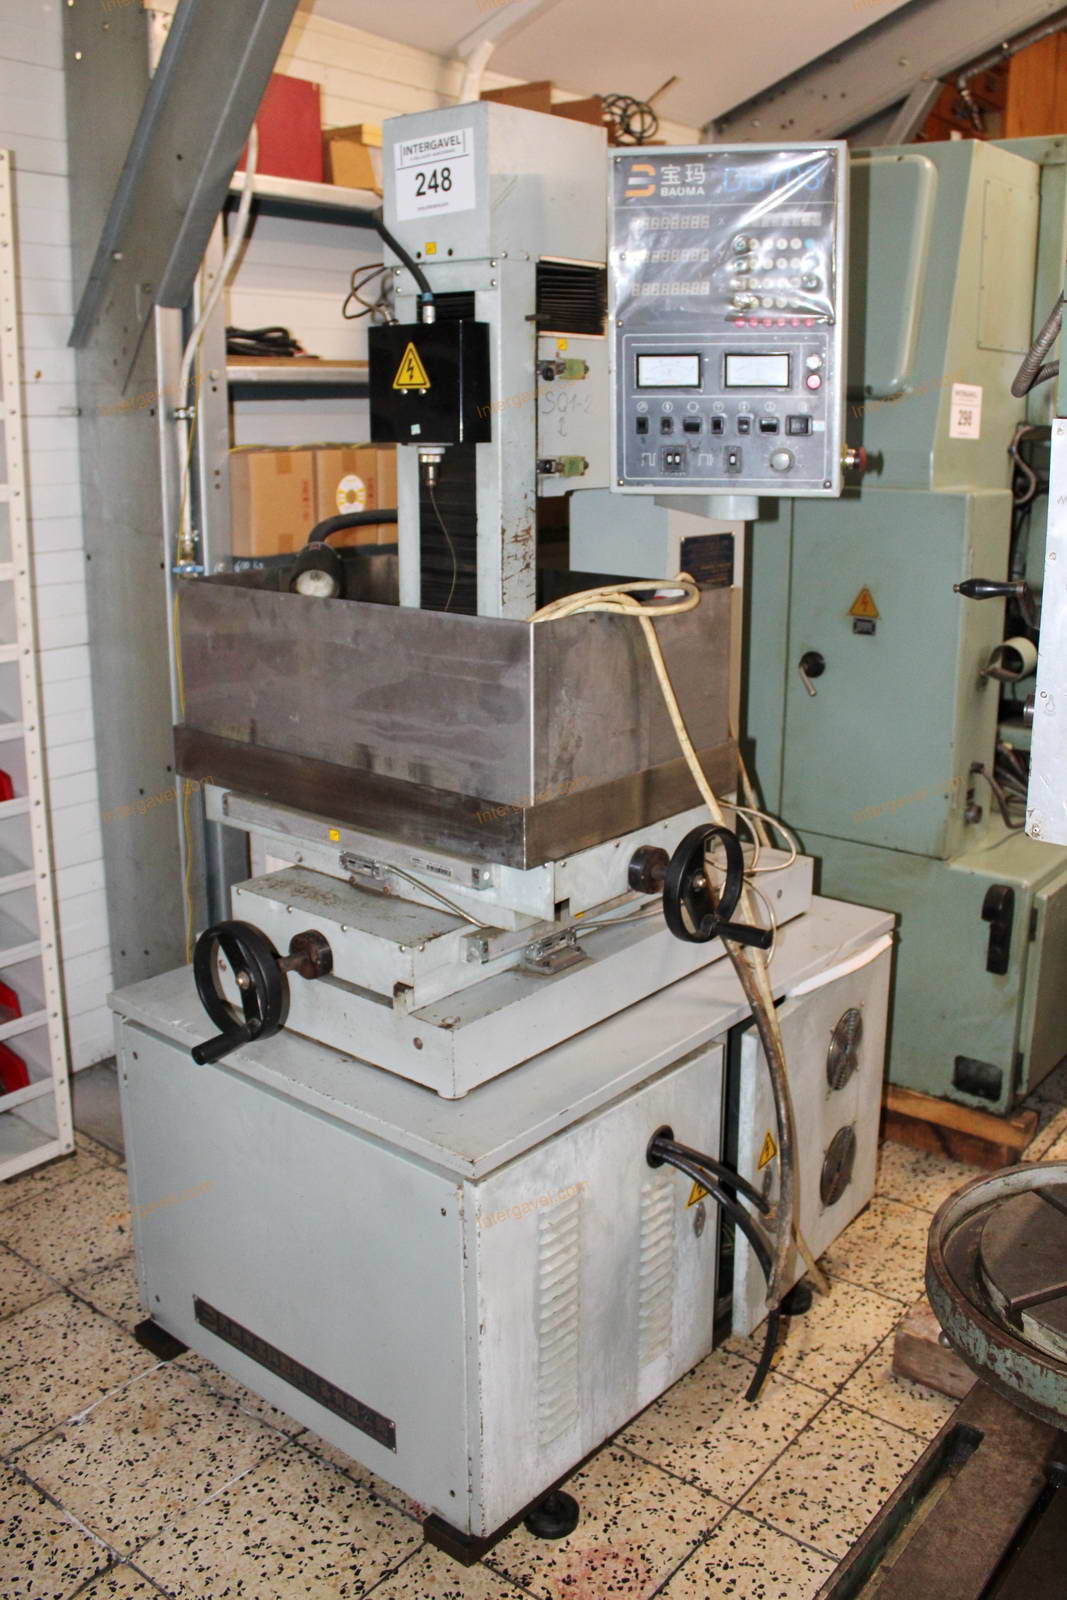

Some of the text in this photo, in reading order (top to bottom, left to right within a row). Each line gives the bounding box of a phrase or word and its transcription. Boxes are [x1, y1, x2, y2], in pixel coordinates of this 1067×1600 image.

[402, 135, 462, 156] INTERGAVEL
[415, 167, 453, 197] 248
[660, 163, 706, 185] 宝玛
